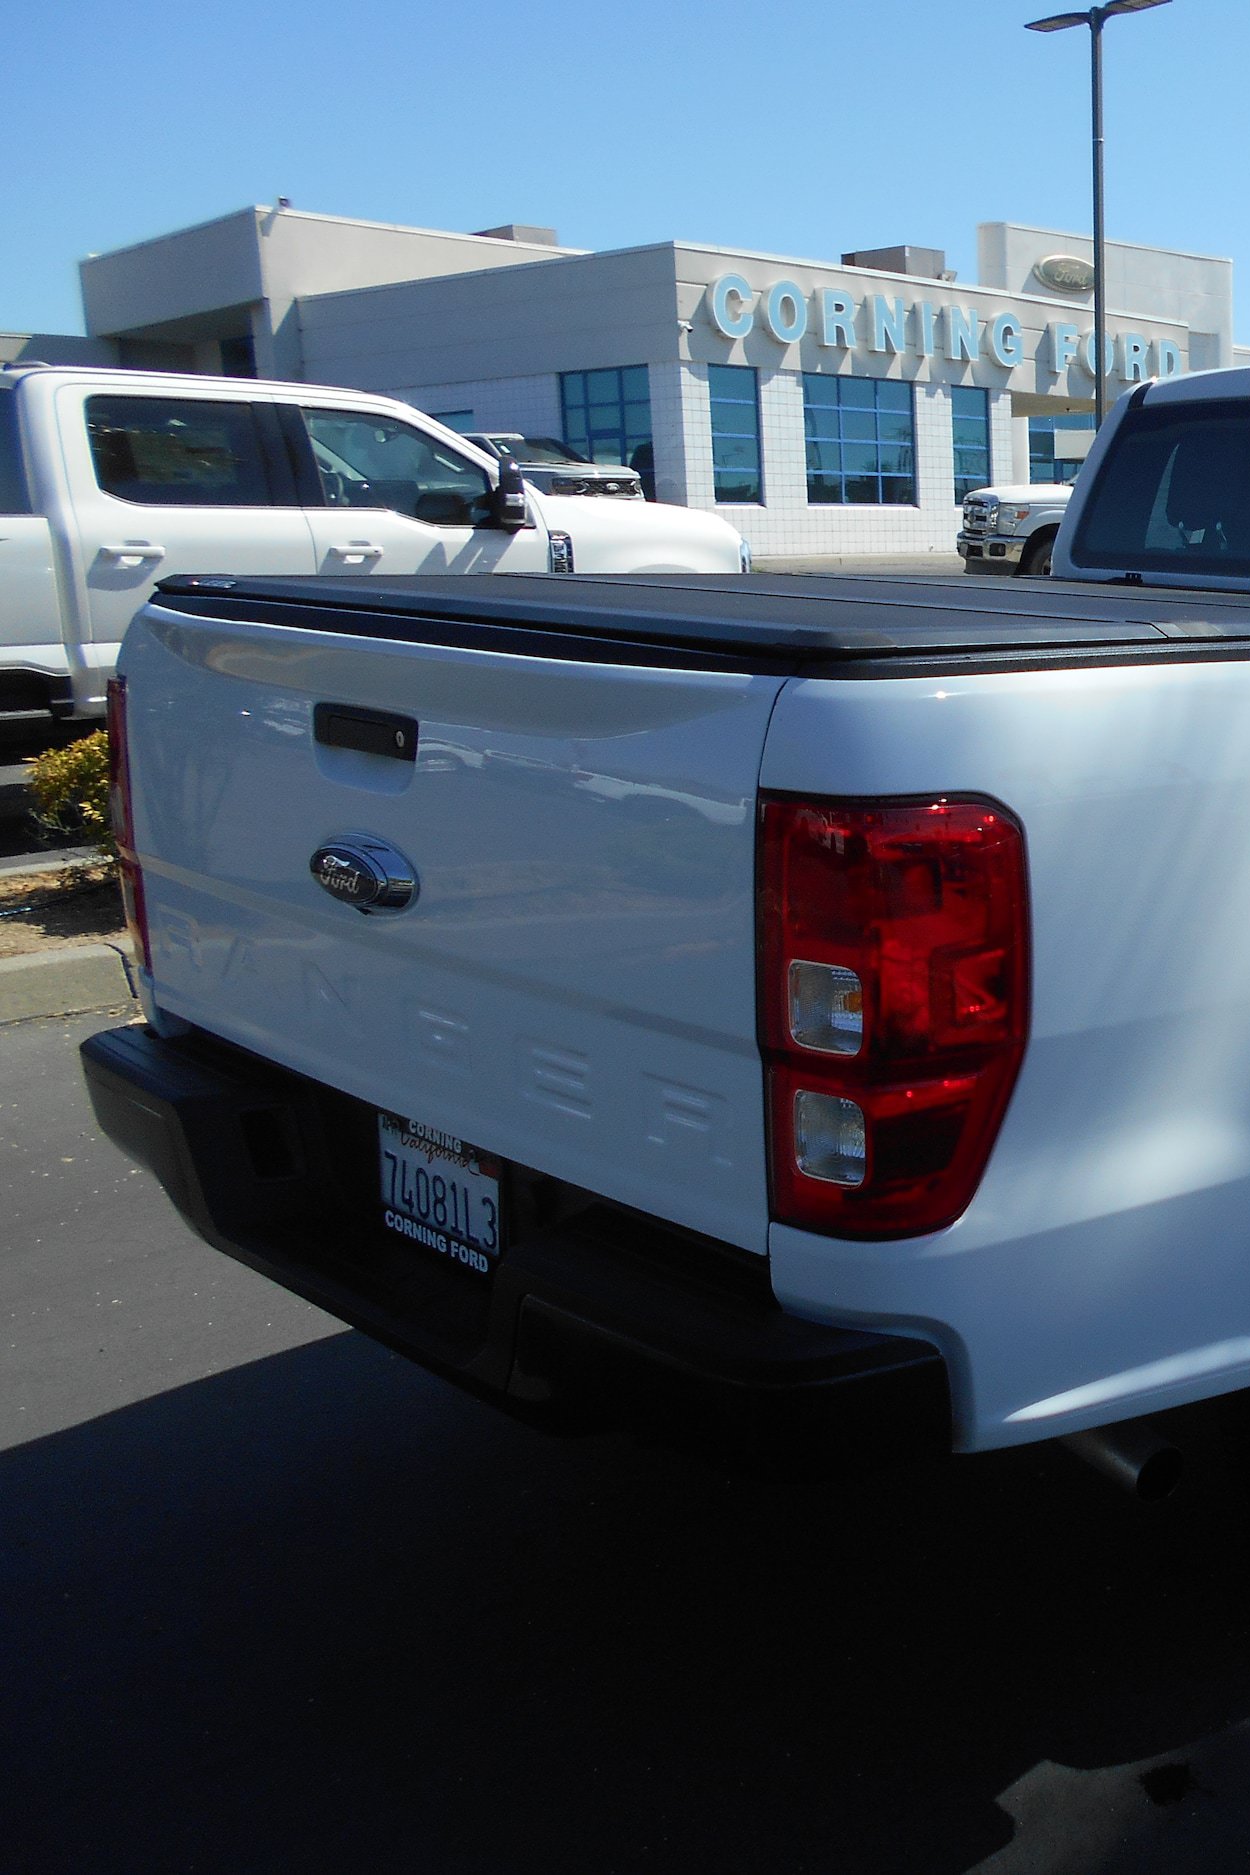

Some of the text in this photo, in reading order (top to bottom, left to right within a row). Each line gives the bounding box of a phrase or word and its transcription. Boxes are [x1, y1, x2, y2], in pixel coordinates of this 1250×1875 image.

[1054, 263, 1087, 285] Ford
[707, 273, 1182, 381] CORNING FORD
[320, 855, 361, 893] Ford
[408, 1119, 462, 1153] CORNING
[384, 1150, 497, 1249] 74081L3
[385, 1209, 489, 1273] CORNING FORD
